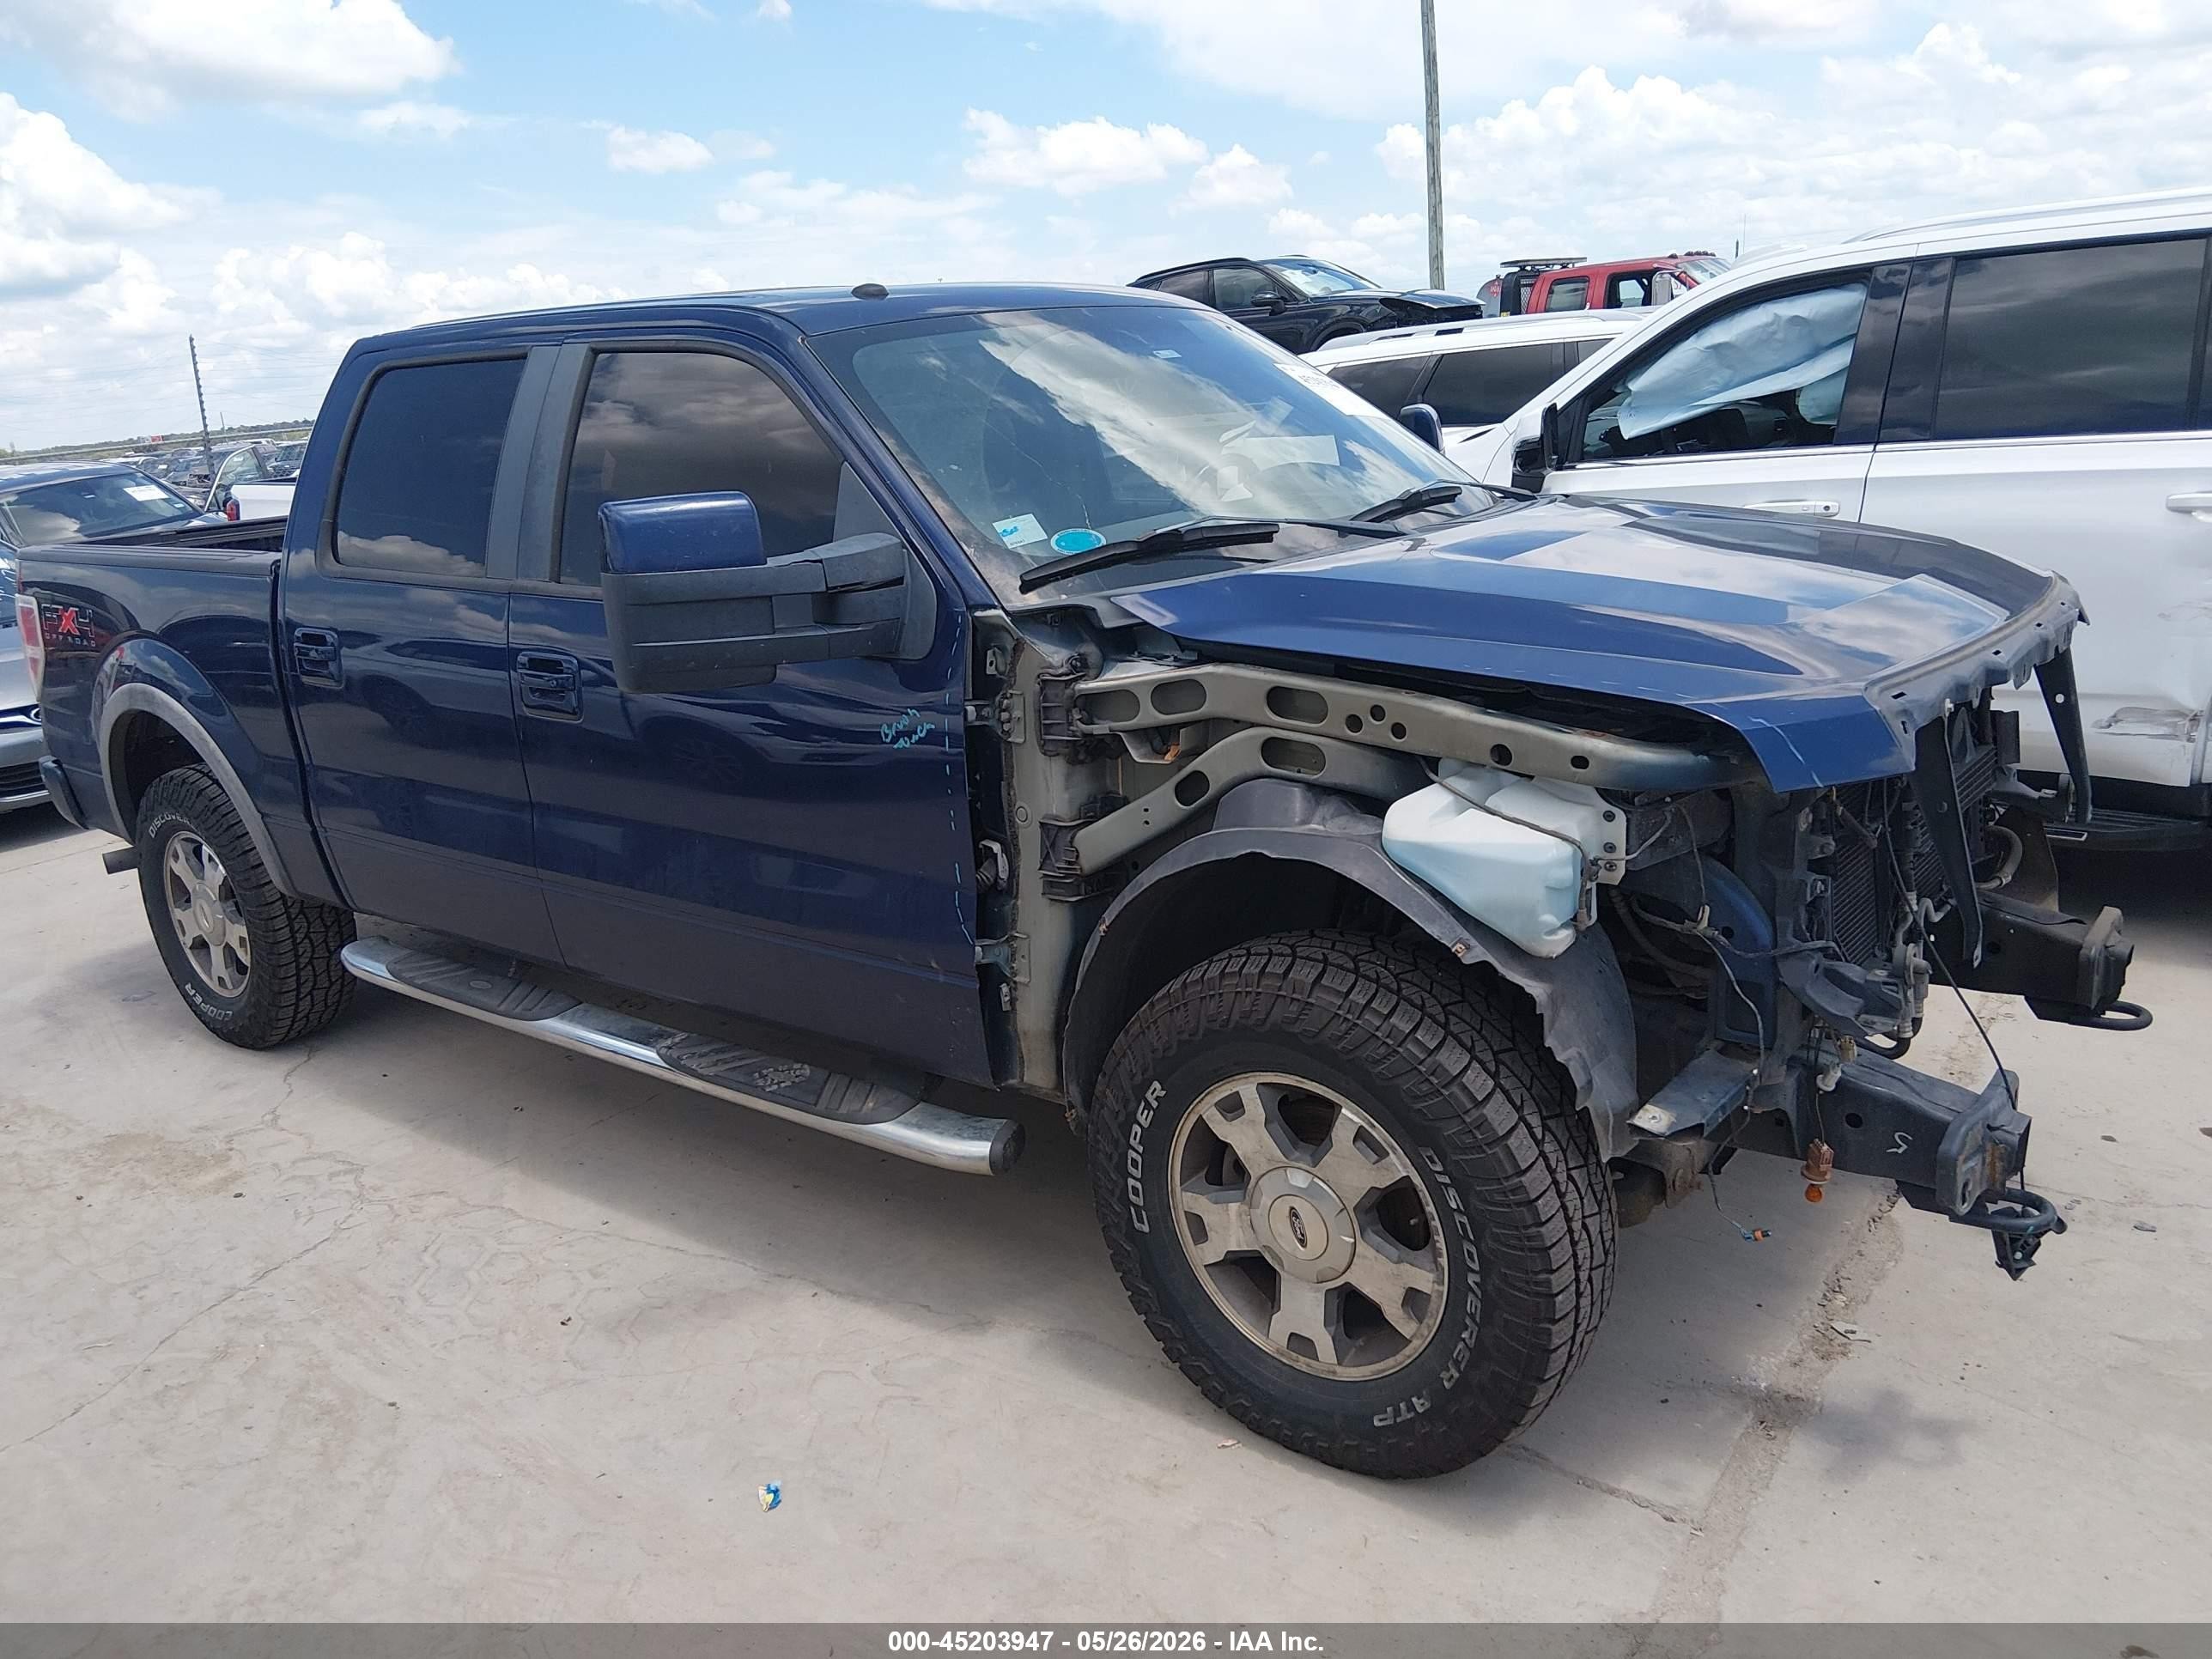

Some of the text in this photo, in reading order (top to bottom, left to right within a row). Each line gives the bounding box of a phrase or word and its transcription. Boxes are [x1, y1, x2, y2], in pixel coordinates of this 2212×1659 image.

[41, 604, 95, 637] FX4
[185, 982, 233, 1021] COOPER
[1127, 1080, 1167, 1234] COOPER
[1373, 1146, 1482, 1427] DISCOVERER ATP
